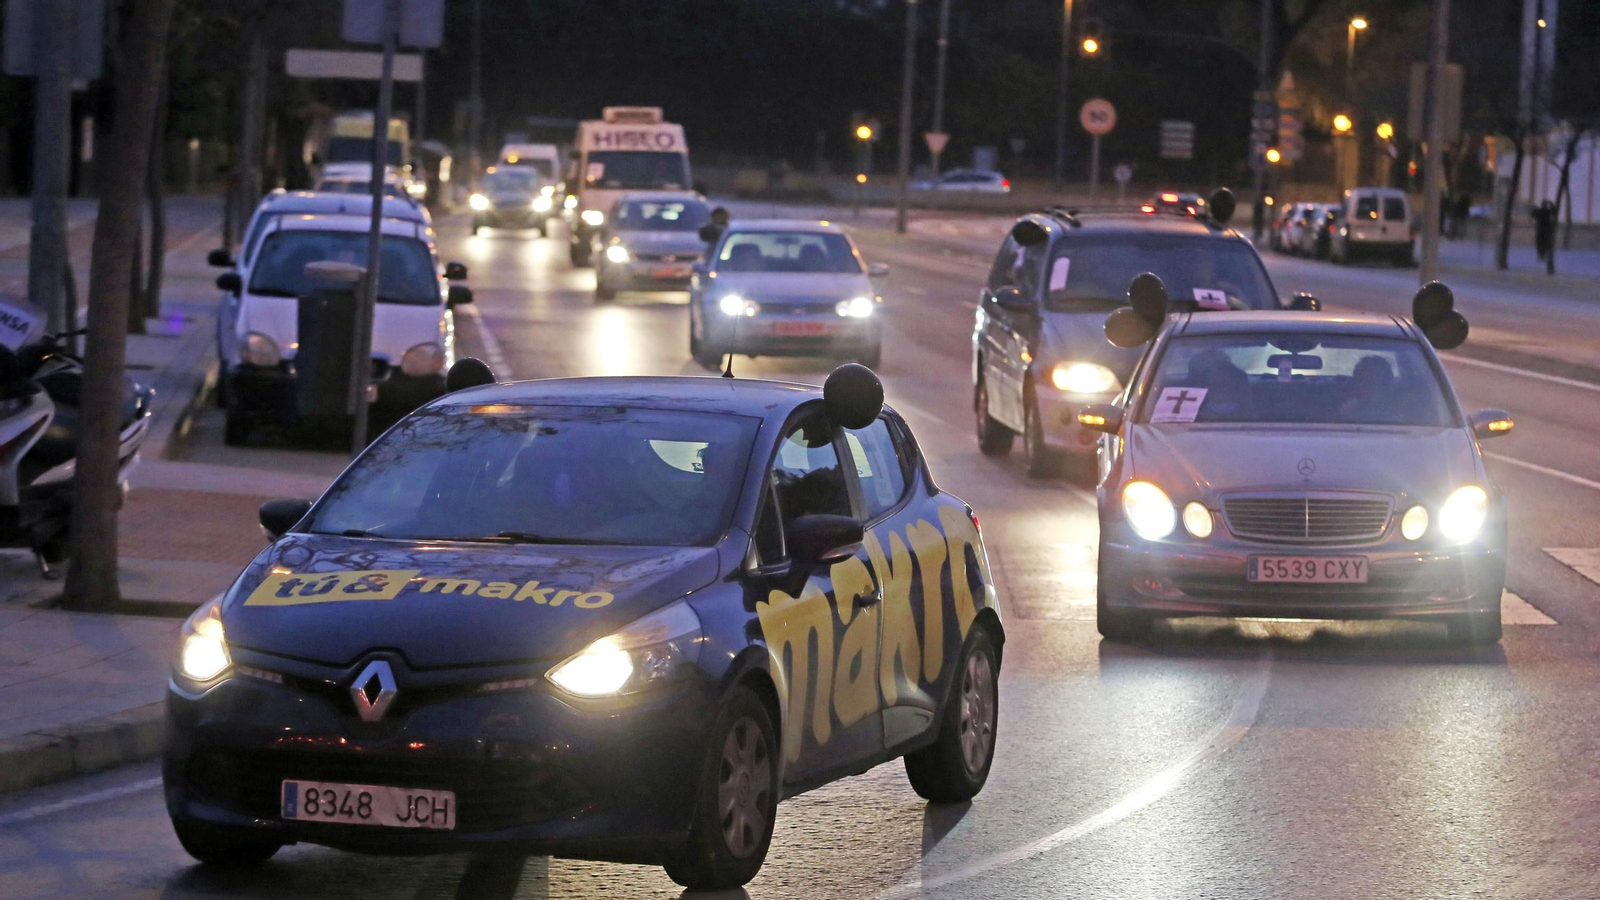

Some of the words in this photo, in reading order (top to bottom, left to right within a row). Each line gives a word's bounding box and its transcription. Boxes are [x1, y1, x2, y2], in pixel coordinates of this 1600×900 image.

[1262, 560, 1317, 579] 5539
[1324, 560, 1363, 579] CXY
[274, 574, 341, 598] tú
[345, 573, 390, 594] &
[419, 576, 615, 609] makro
[304, 787, 373, 820] 8348
[396, 794, 448, 825] JCH
